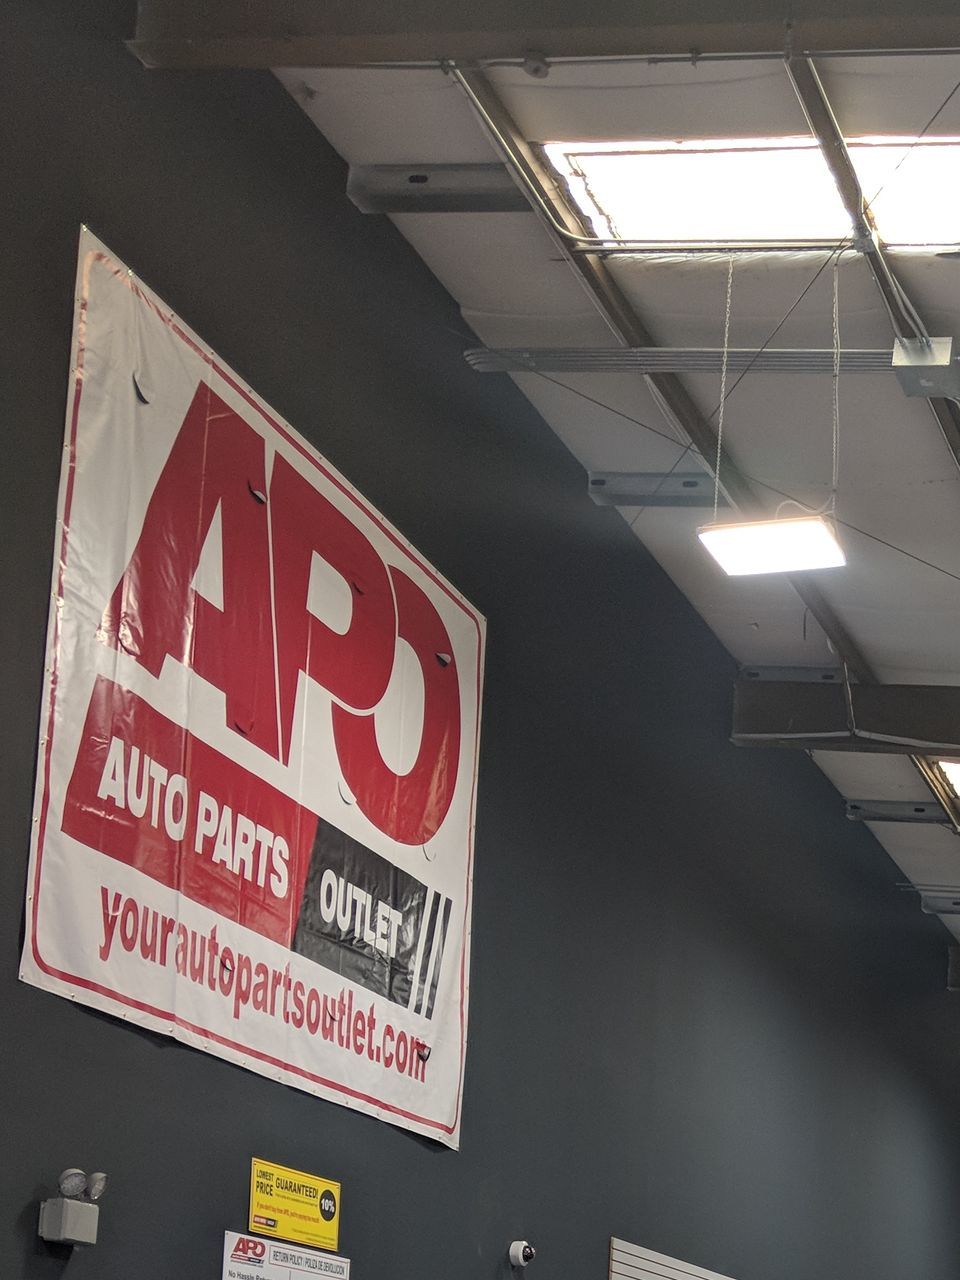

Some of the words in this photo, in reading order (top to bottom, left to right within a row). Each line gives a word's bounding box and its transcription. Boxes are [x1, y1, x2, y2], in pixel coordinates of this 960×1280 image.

[97, 380, 461, 847] APO
[97, 737, 188, 842] AUTO
[195, 790, 290, 899] PARTS
[320, 868, 403, 959] OUTLET
[98, 886, 432, 1084] yourautopartsoutlet.com
[256, 1169, 275, 1182] LOWEST
[256, 1181, 273, 1196] PRICE
[275, 1177, 319, 1199] GUARANTEED!
[320, 1198, 335, 1213] 10%
[233, 1236, 266, 1257] APO
[228, 1270, 236, 1278] No
